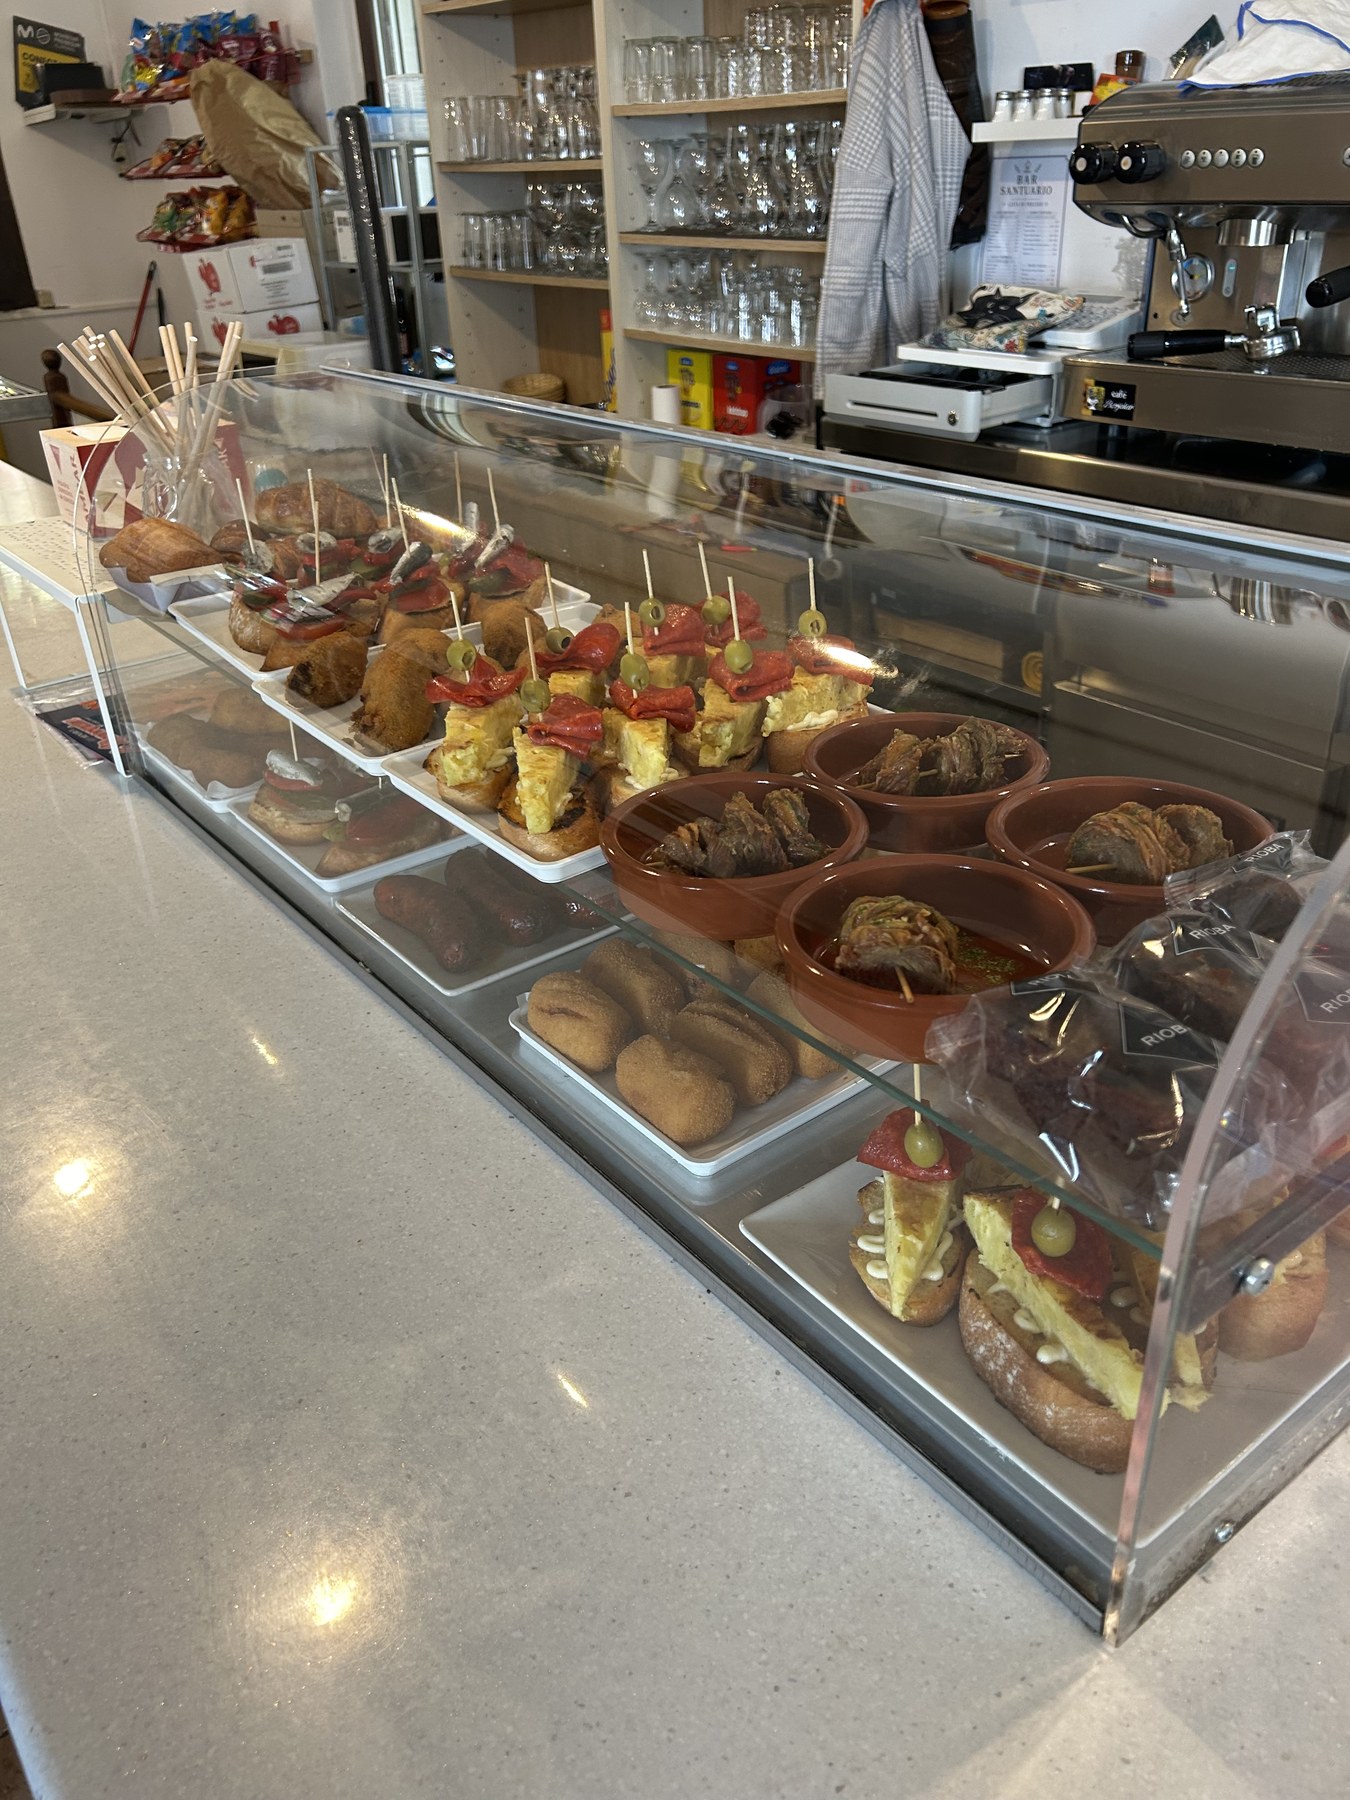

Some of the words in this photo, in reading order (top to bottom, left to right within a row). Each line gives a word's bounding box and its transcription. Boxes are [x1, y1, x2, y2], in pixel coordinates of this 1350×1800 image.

[1016, 174, 1038, 185] BAR
[1000, 185, 1053, 196] SANTUARIO
[1244, 843, 1285, 862] RIOBA
[1189, 923, 1237, 940] RIOBA
[1140, 1024, 1190, 1047] RIOB
